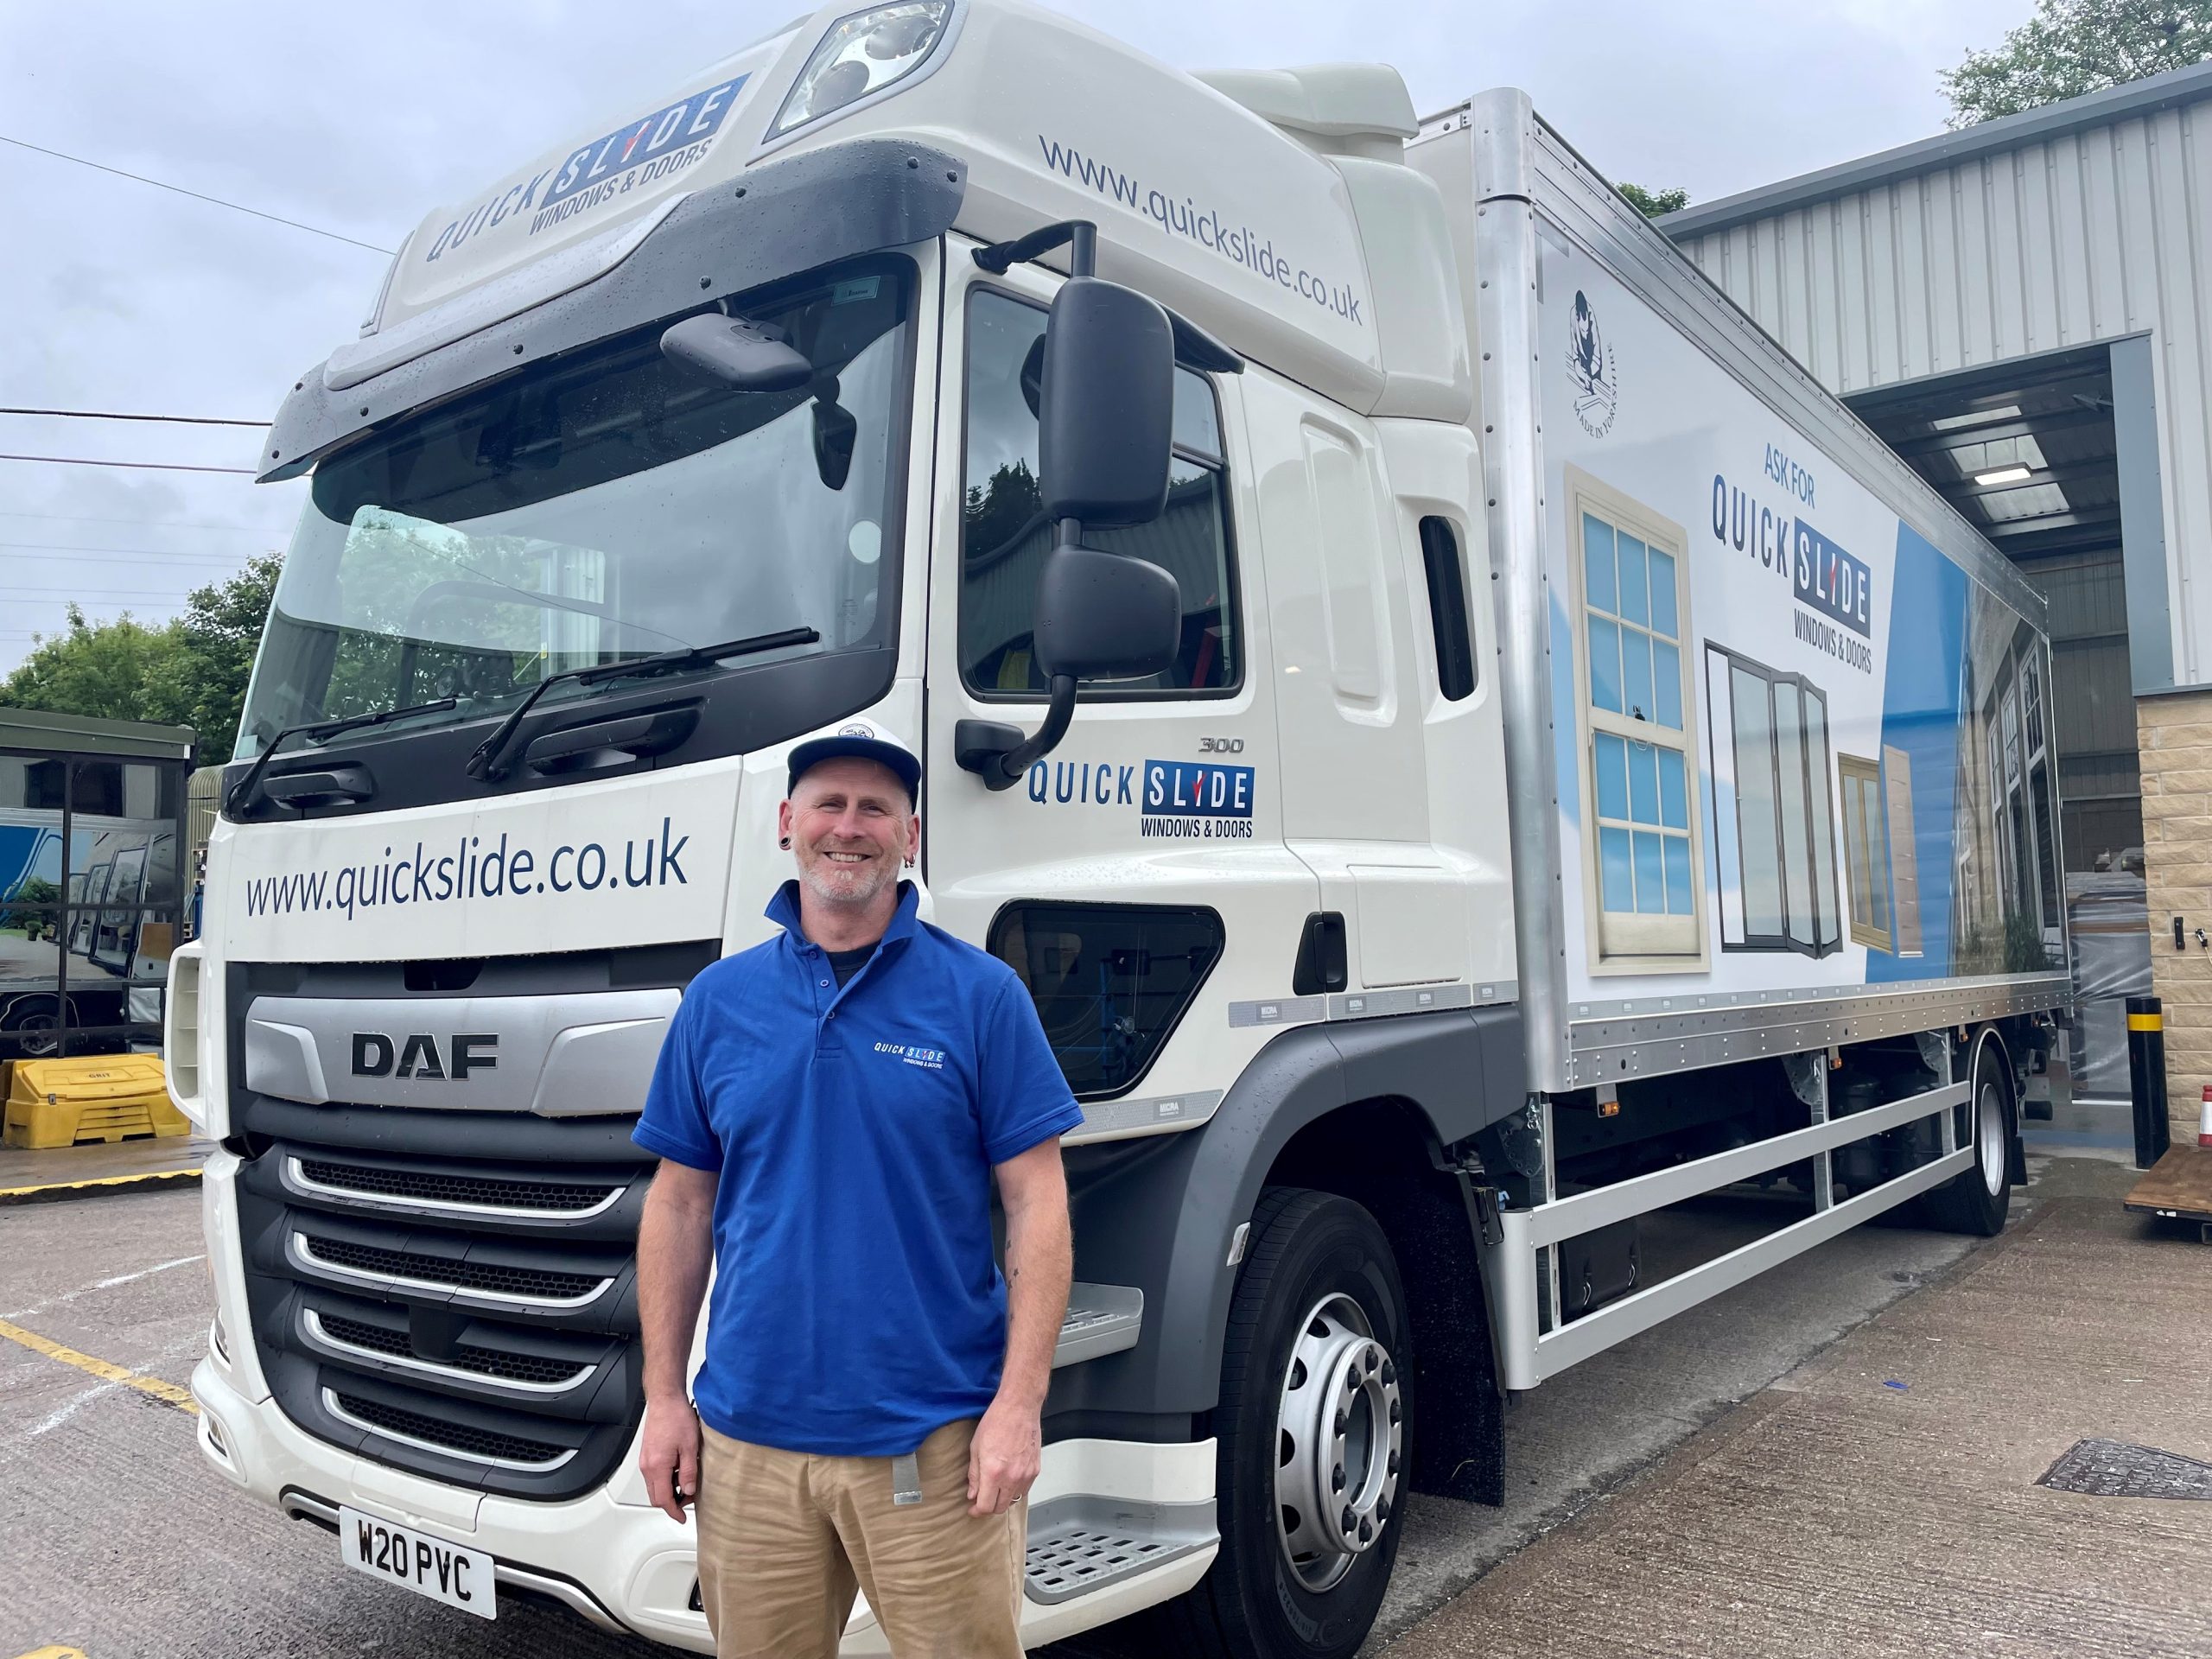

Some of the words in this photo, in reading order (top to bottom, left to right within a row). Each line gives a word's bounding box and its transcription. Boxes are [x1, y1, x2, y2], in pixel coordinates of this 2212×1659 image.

[426, 168, 553, 262] QUICK
[555, 86, 732, 194] SLIDE
[529, 183, 619, 236] WINDOWS
[620, 170, 638, 194] &
[639, 138, 715, 188] DOORS
[1038, 134, 1363, 327] www.quickslide.co.uk
[1573, 400, 1595, 438] MADE
[1764, 442, 1789, 492] ASK
[1791, 462, 1815, 510] FOR
[1712, 474, 1789, 579] QUICK
[1799, 531, 1866, 624] SLIDE
[1794, 607, 1837, 658] WINDOWS
[1838, 636, 1845, 660] &
[1846, 637, 1872, 675] DOORS
[1198, 737, 1244, 754] 300
[1028, 760, 1135, 805] QUICK
[1148, 766, 1248, 810] SLIDE
[1141, 818, 1200, 838] WINDOWS
[1205, 820, 1212, 838] &
[1215, 820, 1253, 839] DOORS
[246, 817, 690, 921] www.quickslide.co.uk
[350, 1032, 499, 1082] DAF
[874, 1042, 906, 1055] QUICK
[907, 1048, 944, 1062] SLIDE
[357, 1519, 408, 1579] W20
[416, 1540, 472, 1602] PVC
